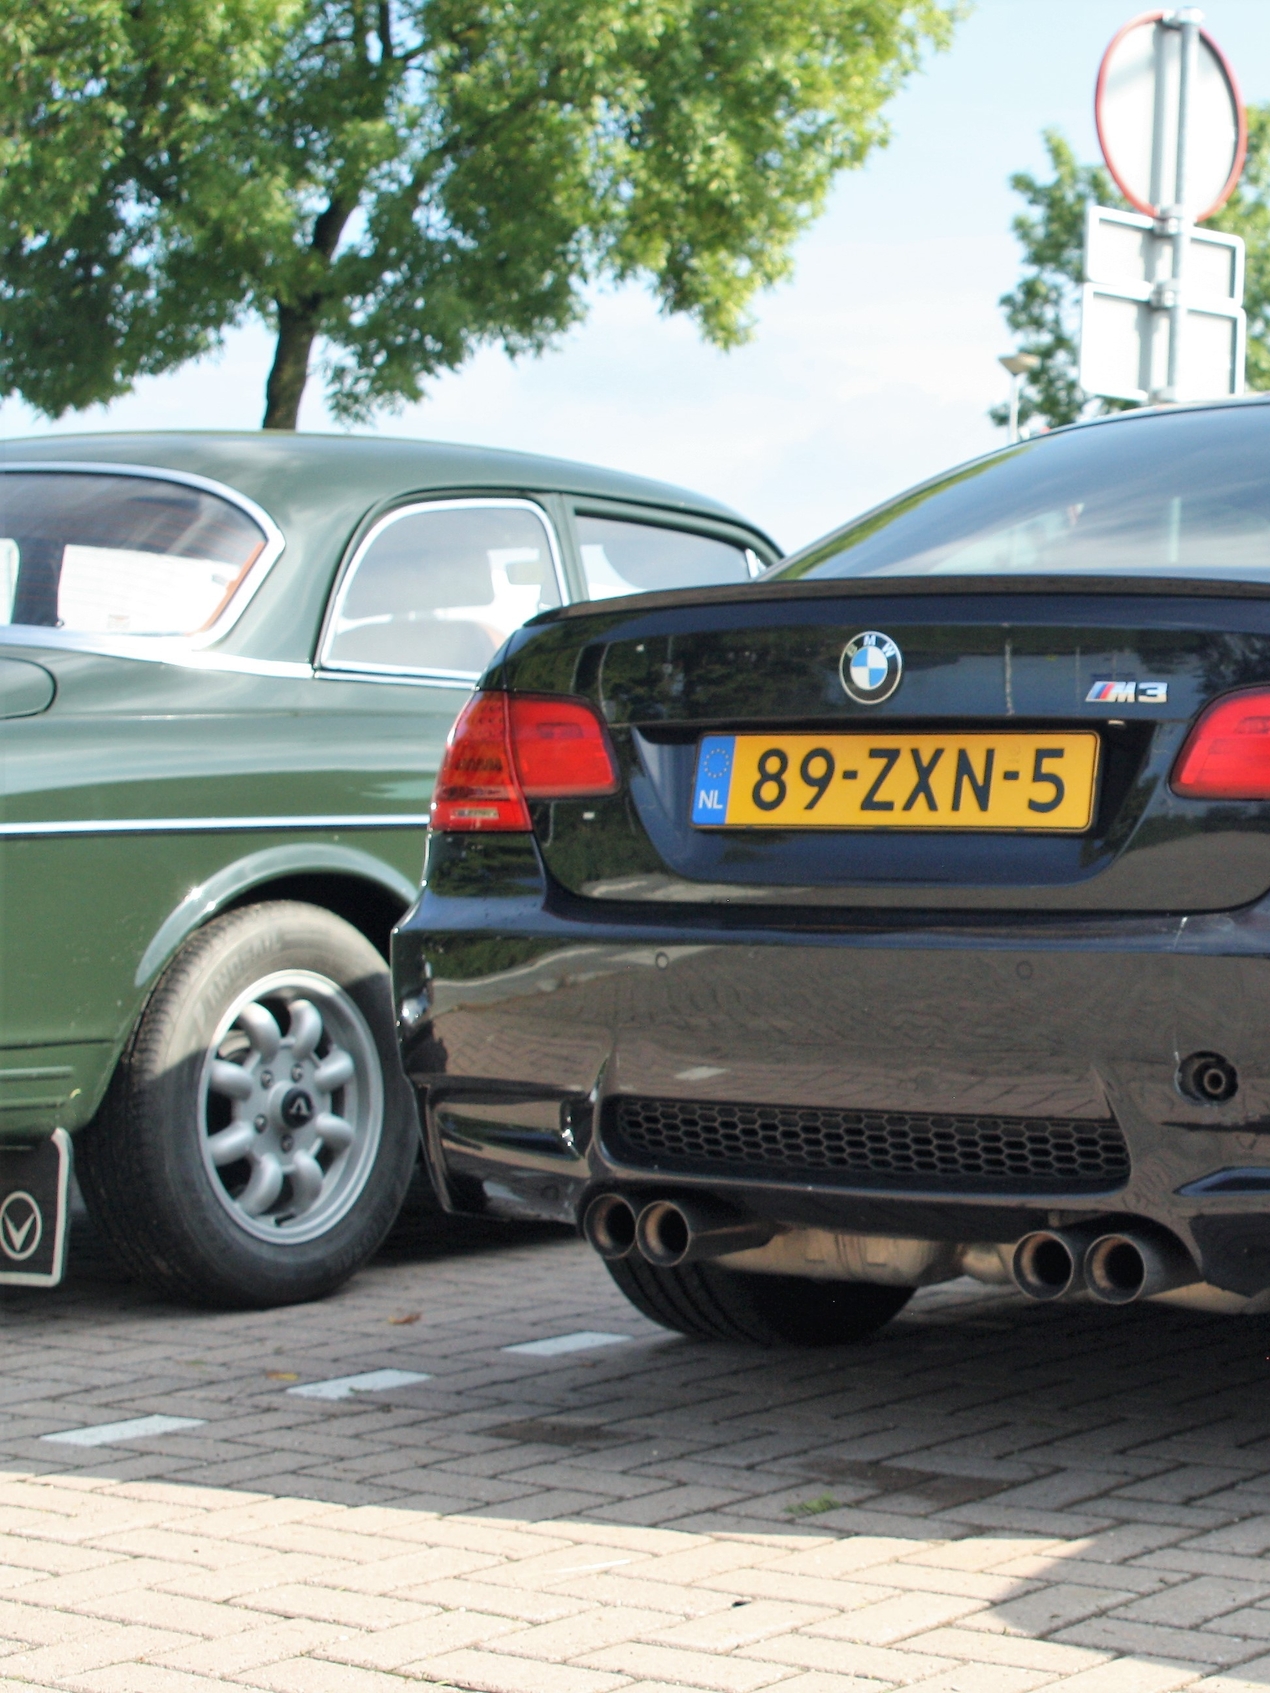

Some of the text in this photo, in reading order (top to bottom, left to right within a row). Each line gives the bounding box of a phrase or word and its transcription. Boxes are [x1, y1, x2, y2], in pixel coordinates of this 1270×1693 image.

[846, 634, 896, 658] BMW
[1085, 681, 1168, 703] M3
[752, 747, 1065, 813] 89-ZXN-5
[698, 789, 723, 810] NL
